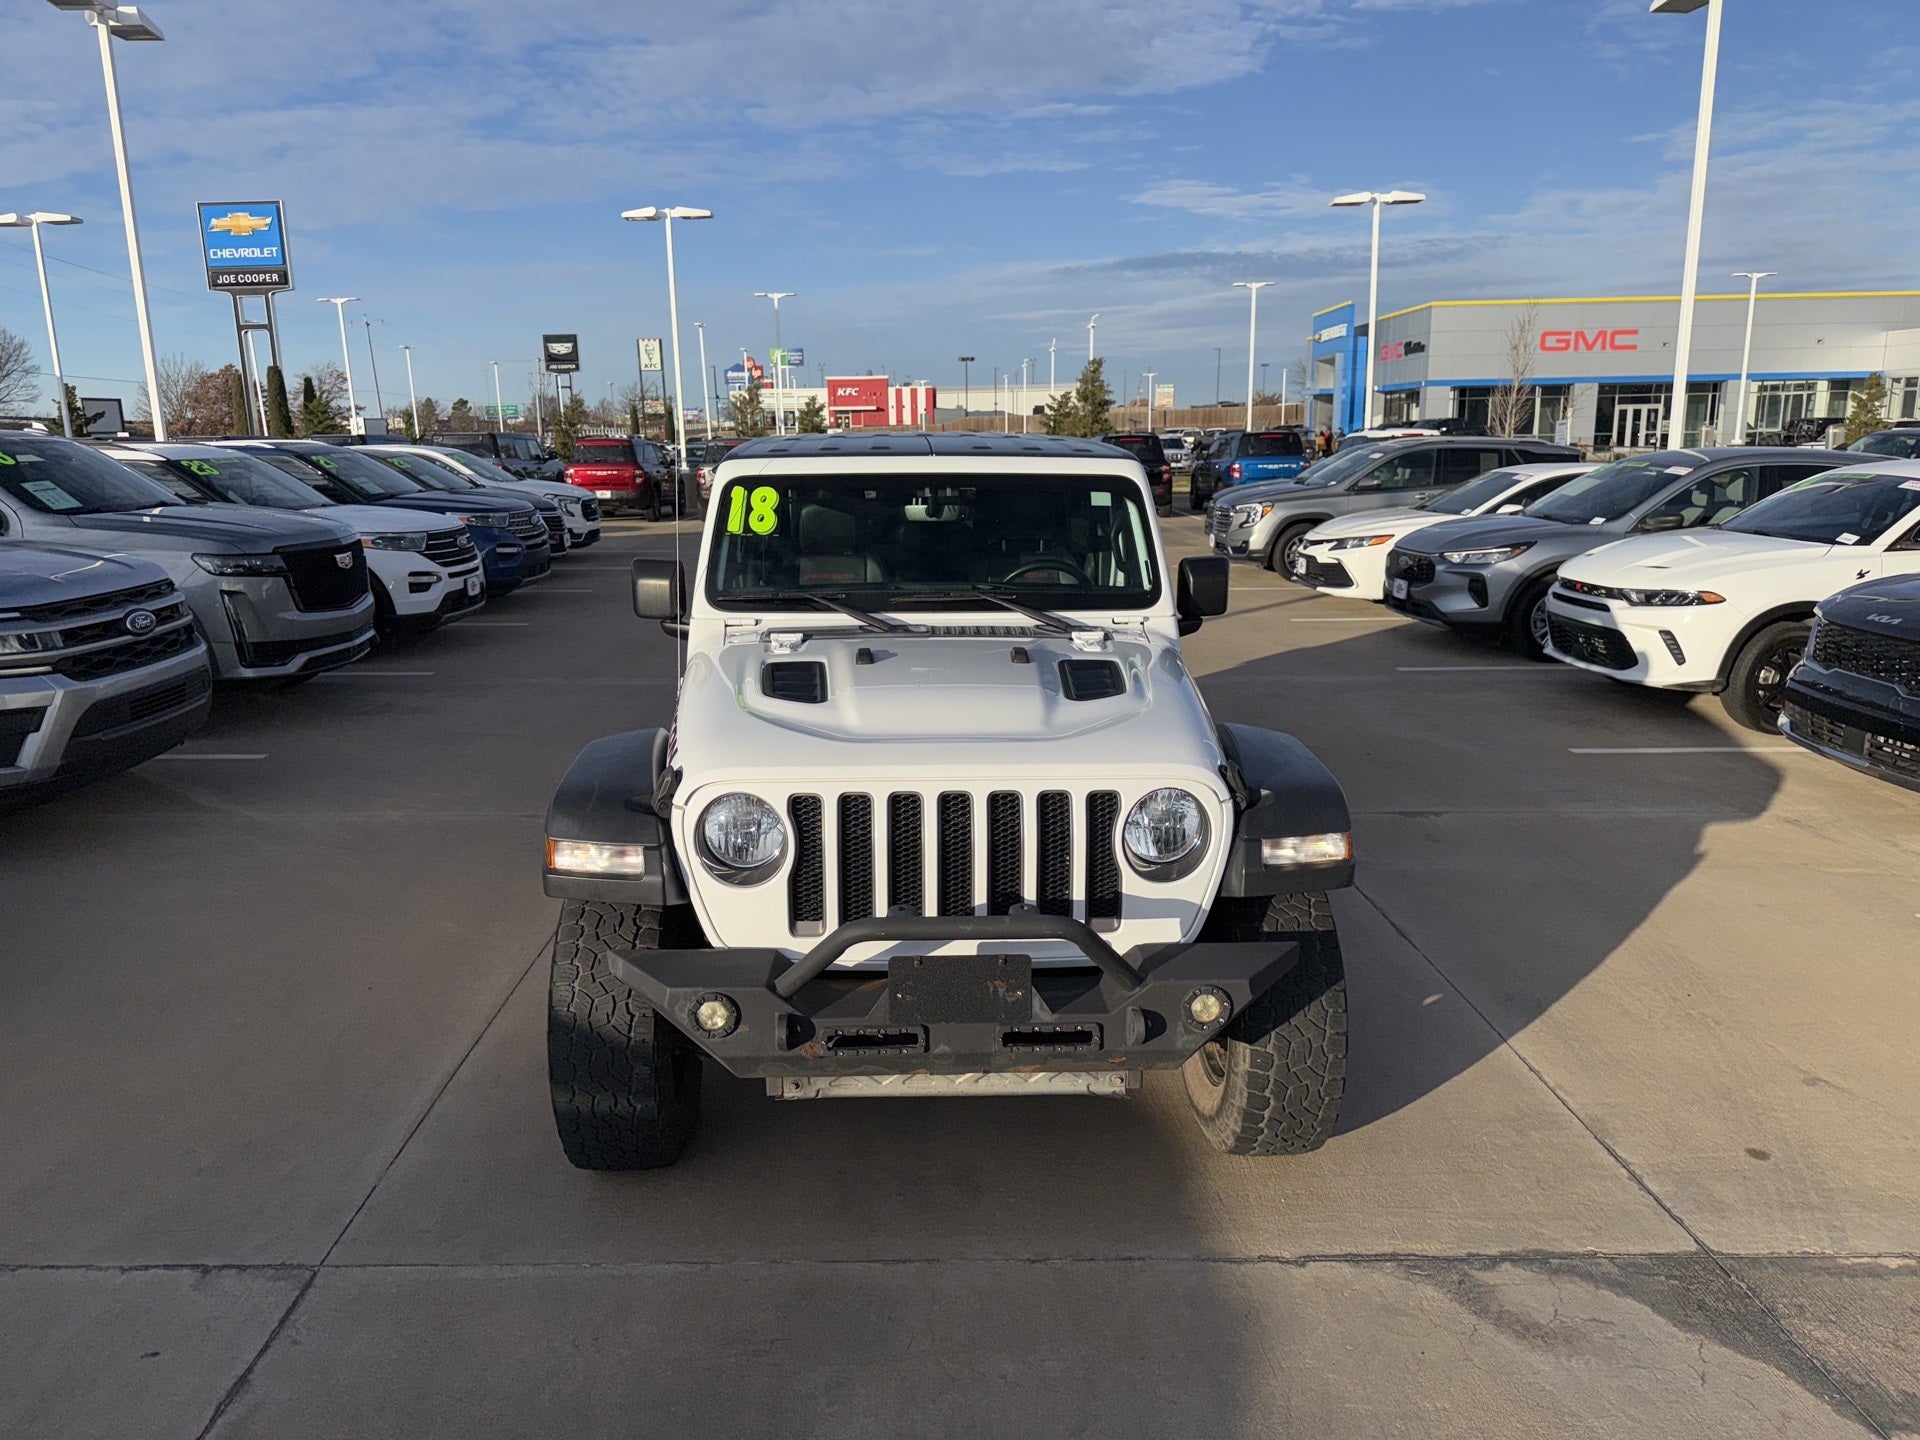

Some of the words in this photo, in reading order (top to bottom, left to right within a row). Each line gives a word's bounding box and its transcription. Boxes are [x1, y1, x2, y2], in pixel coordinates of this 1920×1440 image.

[209, 247, 278, 259] CHEVROLET
[217, 274, 236, 284] JOE
[238, 273, 279, 283] COOPER
[1539, 329, 1639, 352] GMC
[836, 387, 860, 397] KFC
[180, 460, 220, 476] 23
[727, 485, 780, 535] 18
[135, 615, 151, 629] Ford
